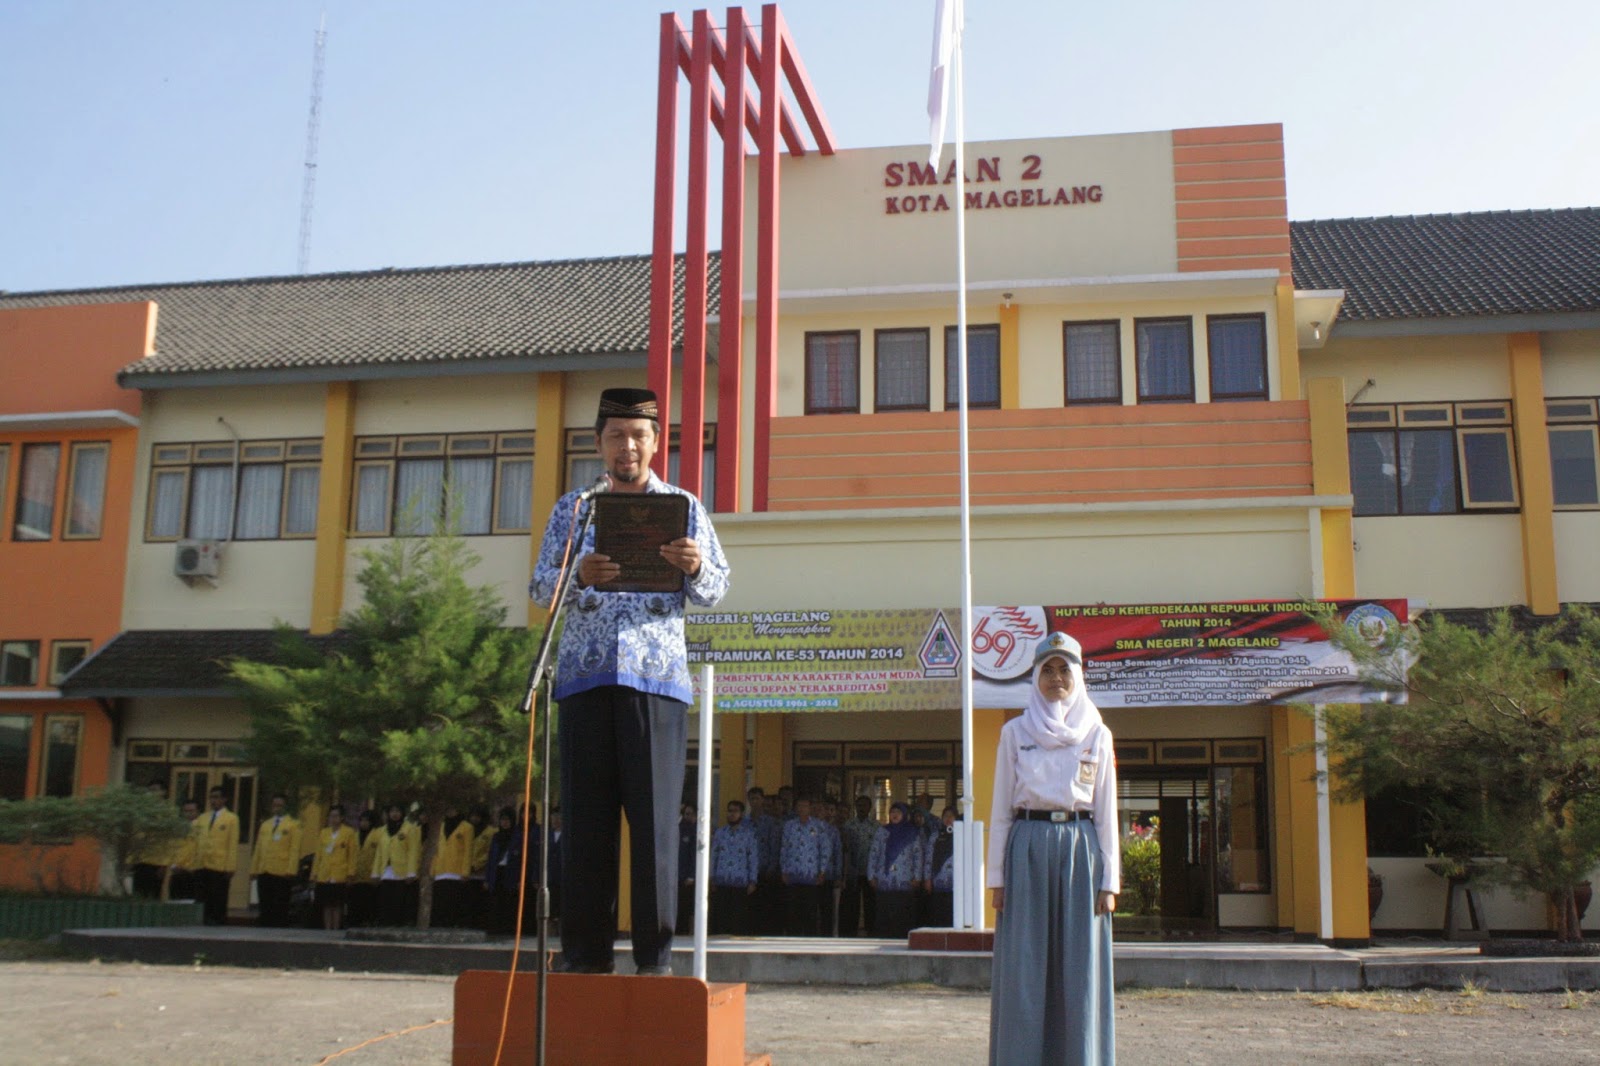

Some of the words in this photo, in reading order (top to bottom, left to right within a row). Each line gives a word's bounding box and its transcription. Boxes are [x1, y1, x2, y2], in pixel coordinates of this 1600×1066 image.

[885, 156, 1001, 187] SMAN
[1021, 154, 1042, 181] 2
[886, 193, 950, 215] KOTA
[964, 184, 1104, 209] MAGELANG
[1055, 607, 1080, 617] HUT
[1083, 606, 1116, 616] KE-69
[1119, 604, 1206, 615] KEMERDEKAAN
[1210, 603, 1270, 613] REPUBLIK
[686, 614, 739, 625] NEGERI
[752, 612, 830, 623] MAGELANG
[1161, 618, 1201, 629] TAHUN
[1203, 617, 1232, 627] 2014
[753, 623, 832, 637] Mengucapkan
[972, 616, 1016, 668] 69
[1116, 639, 1143, 650] SMA
[1146, 638, 1194, 649] NEGERI
[1197, 638, 1205, 647] 2
[1208, 637, 1280, 647] MAGELANG
[705, 650, 773, 661] PRAMUKA
[775, 650, 815, 661] KE-53
[818, 649, 867, 660] TAHUN
[870, 648, 904, 659] 2014
[1087, 660, 1123, 669] Dengan
[1124, 658, 1171, 668] Semangat
[1173, 656, 1226, 666] Proklamasi
[1228, 656, 1239, 665] 17
[1242, 656, 1281, 667] Agustus
[1283, 655, 1310, 666] 1945,
[713, 673, 790, 683] EMBENTUKAN
[793, 672, 853, 683] KARAKTER
[855, 671, 887, 682] KAUM
[889, 670, 922, 681] MUDA
[1109, 671, 1146, 679] Suksesi
[1148, 669, 1218, 680] Kepemimpinan
[1219, 668, 1261, 677] Nasional
[1263, 668, 1288, 676] Hasil
[1289, 667, 1322, 676] Pemilu
[1324, 666, 1349, 675] 2014
[722, 684, 758, 694] GUGUS
[761, 683, 797, 694] DEPAN
[800, 682, 887, 693] TERAKREDITASI
[1110, 681, 1161, 692] Kelanjutan
[1163, 680, 1229, 690] Pembangunan
[1230, 679, 1265, 689] Menuju
[1267, 678, 1314, 688] Indonesia
[1125, 693, 1149, 703] yang
[1150, 692, 1179, 701] Makin
[1181, 691, 1204, 702] Maju
[1206, 691, 1225, 700] dan
[1226, 690, 1272, 701] Sejahtera
[733, 699, 783, 709] AGUSTUS
[786, 699, 808, 709] 1961
